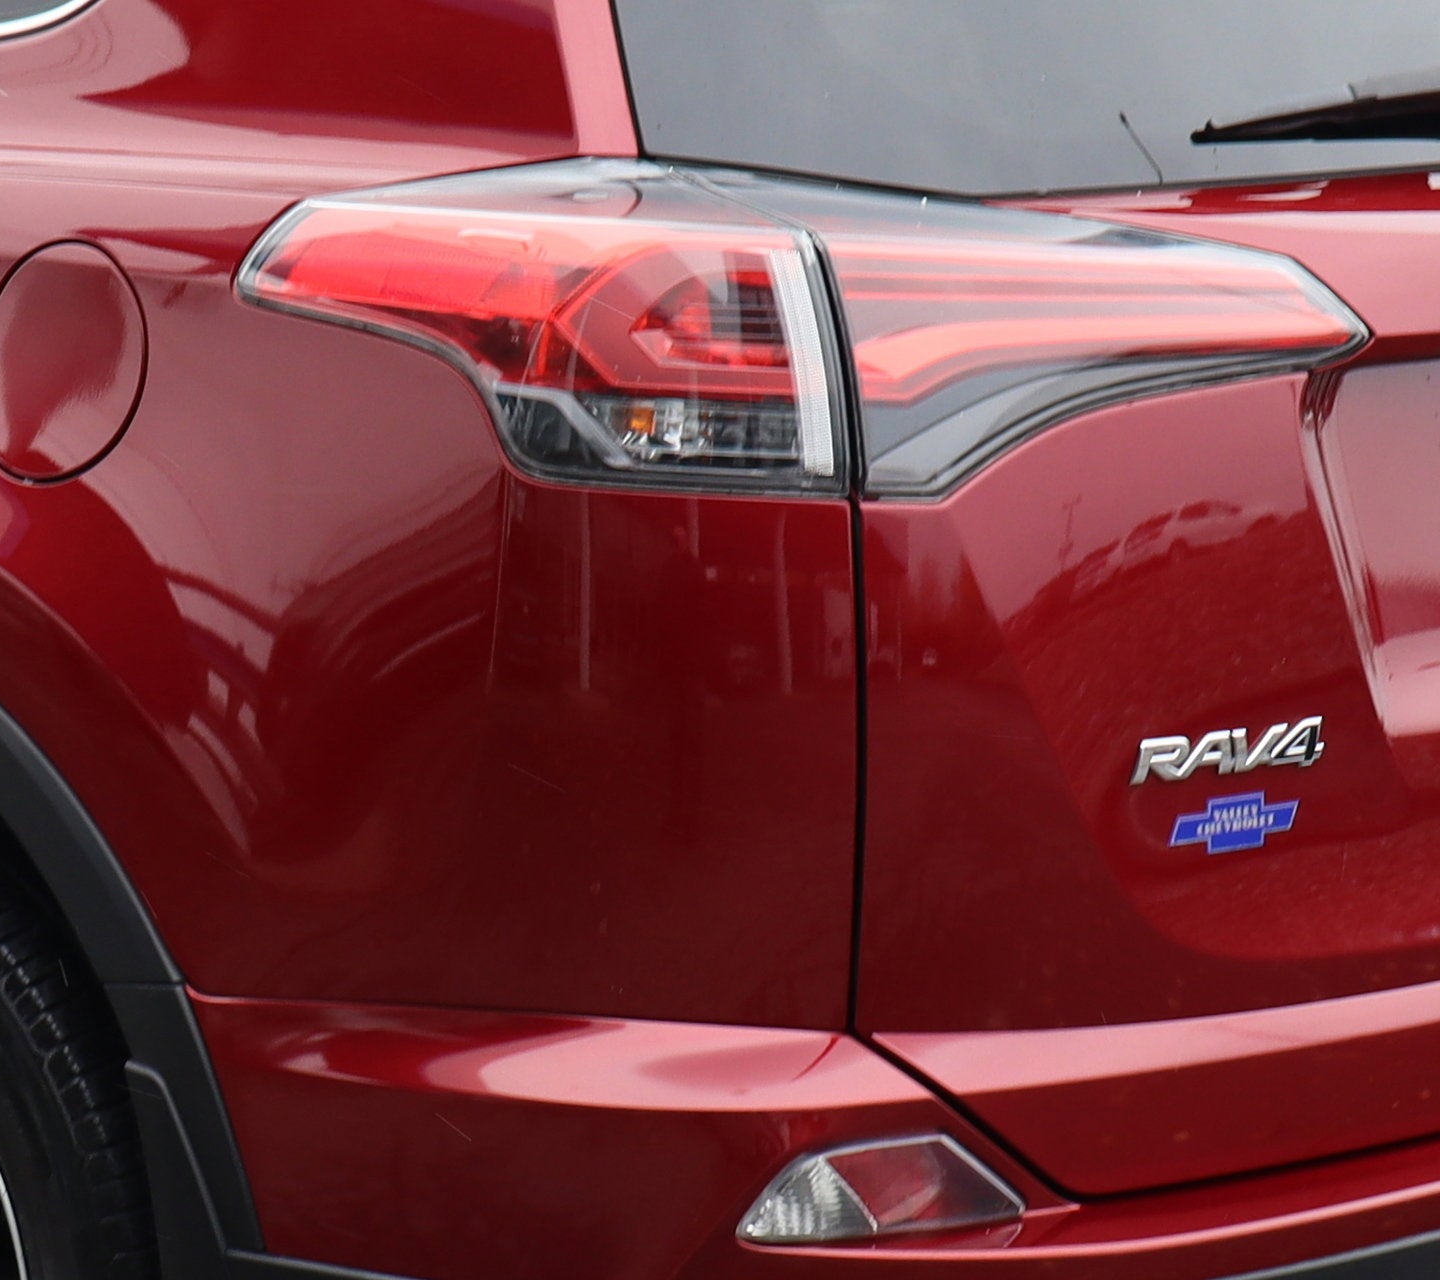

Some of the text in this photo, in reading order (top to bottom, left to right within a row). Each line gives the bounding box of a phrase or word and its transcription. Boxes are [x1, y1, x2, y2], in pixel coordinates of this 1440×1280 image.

[1129, 715, 1325, 787] RAV4
[1196, 812, 1275, 836] CHEVROLET
[1213, 803, 1259, 822] VALLEY
